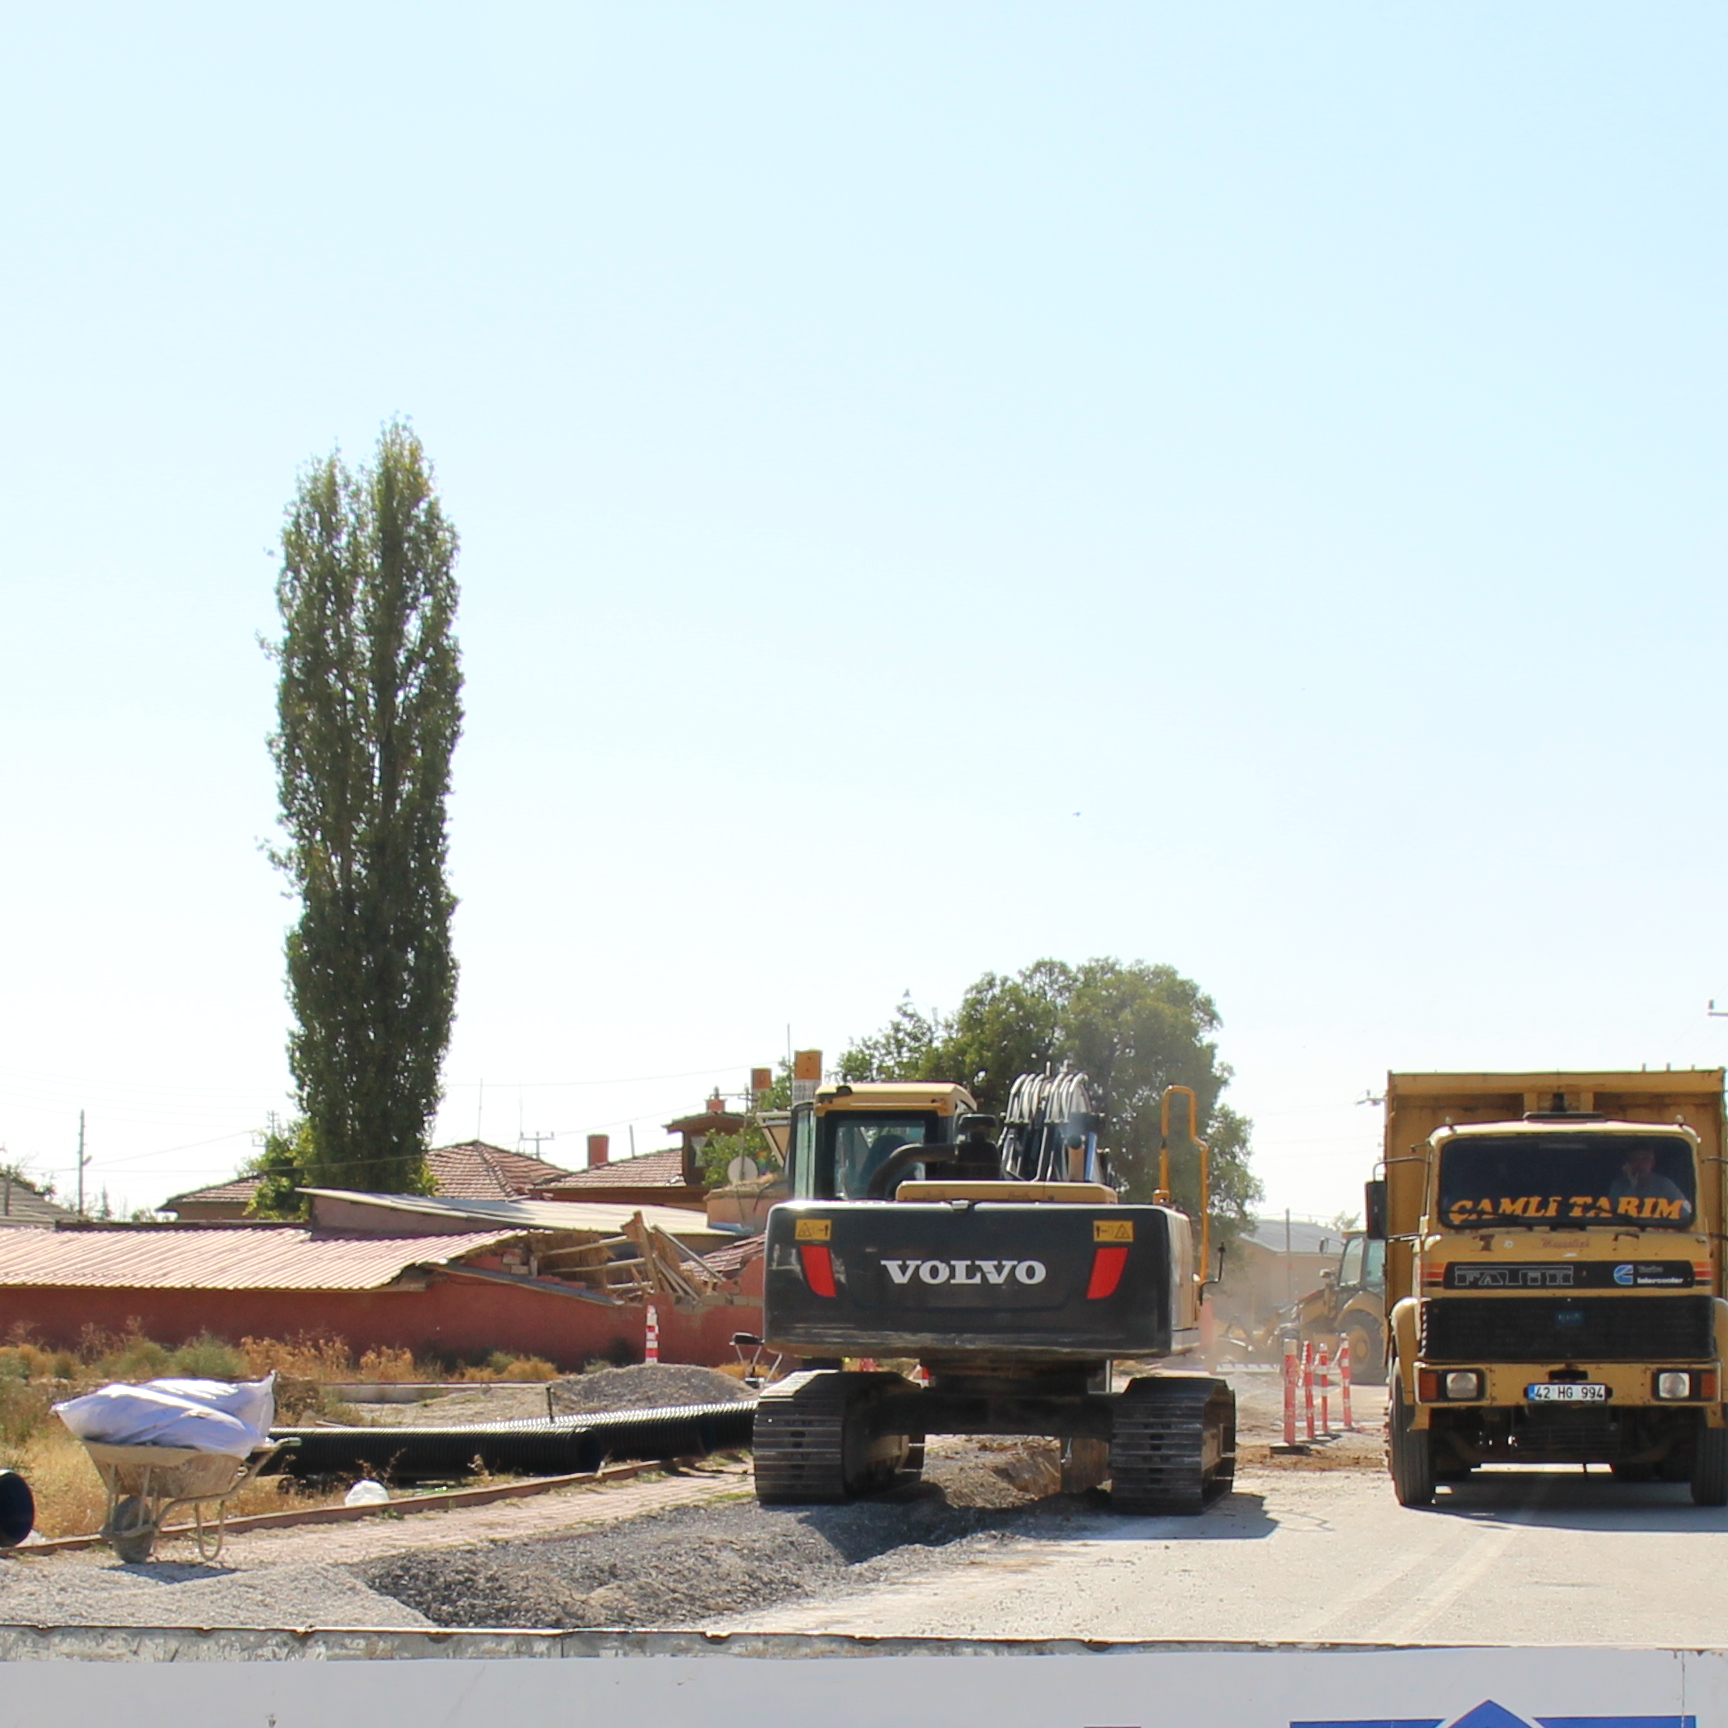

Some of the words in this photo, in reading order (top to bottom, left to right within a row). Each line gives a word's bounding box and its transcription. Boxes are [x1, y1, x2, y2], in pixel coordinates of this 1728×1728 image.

[1568, 1196, 1684, 1220] TARIM
[880, 1260, 1047, 1285] VOLVO
[1535, 1387, 1550, 1398] 42
[1558, 1387, 1573, 1398] HG
[1581, 1387, 1603, 1398] 994
